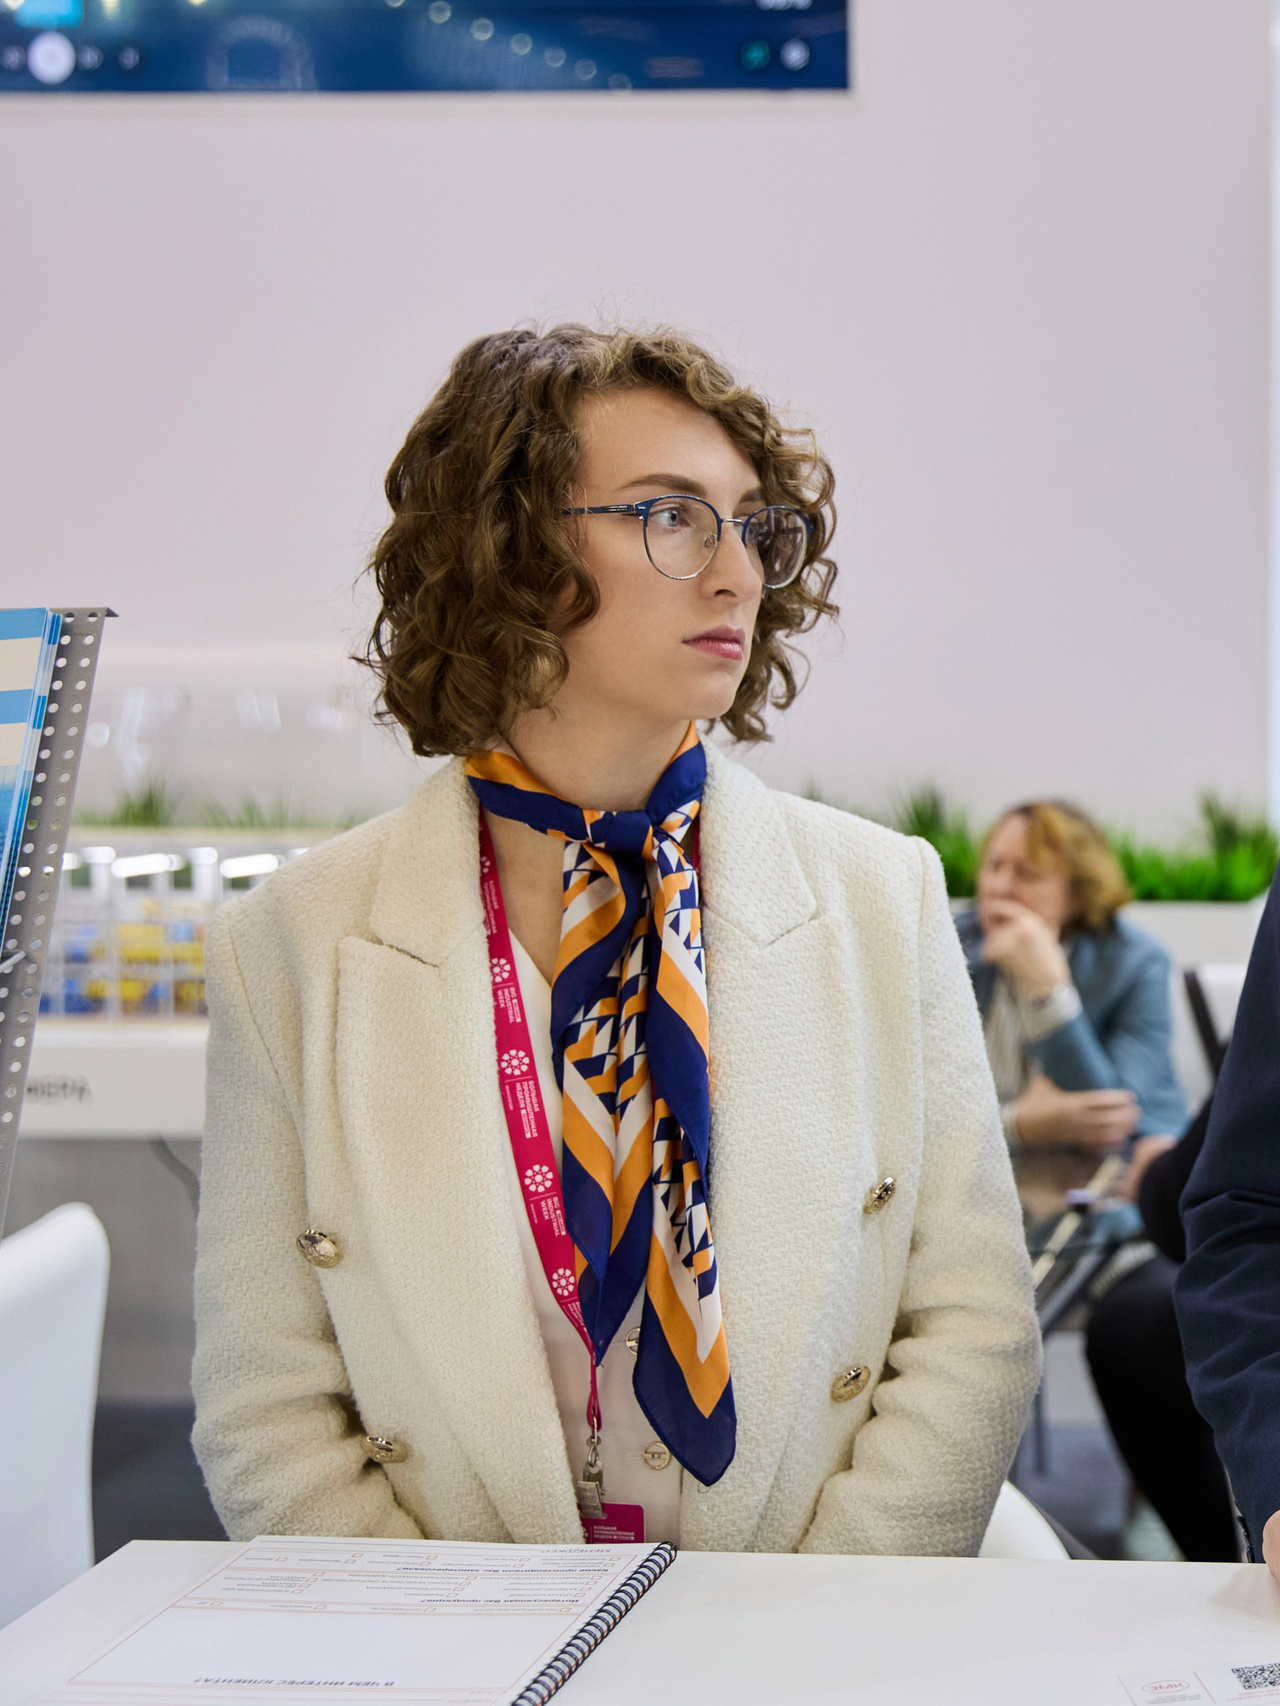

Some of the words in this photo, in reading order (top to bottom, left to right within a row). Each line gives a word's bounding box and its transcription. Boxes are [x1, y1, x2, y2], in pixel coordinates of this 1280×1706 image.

[515, 1082, 525, 1108] НЕДЕЛЯ
[522, 1081, 538, 1138] ПРОМЫШЛЕННАЯ
[528, 1080, 540, 1112] БОЛЬШАЯ
[540, 1200, 550, 1220] WEEK
[547, 1198, 560, 1237] INDUSTRIAL
